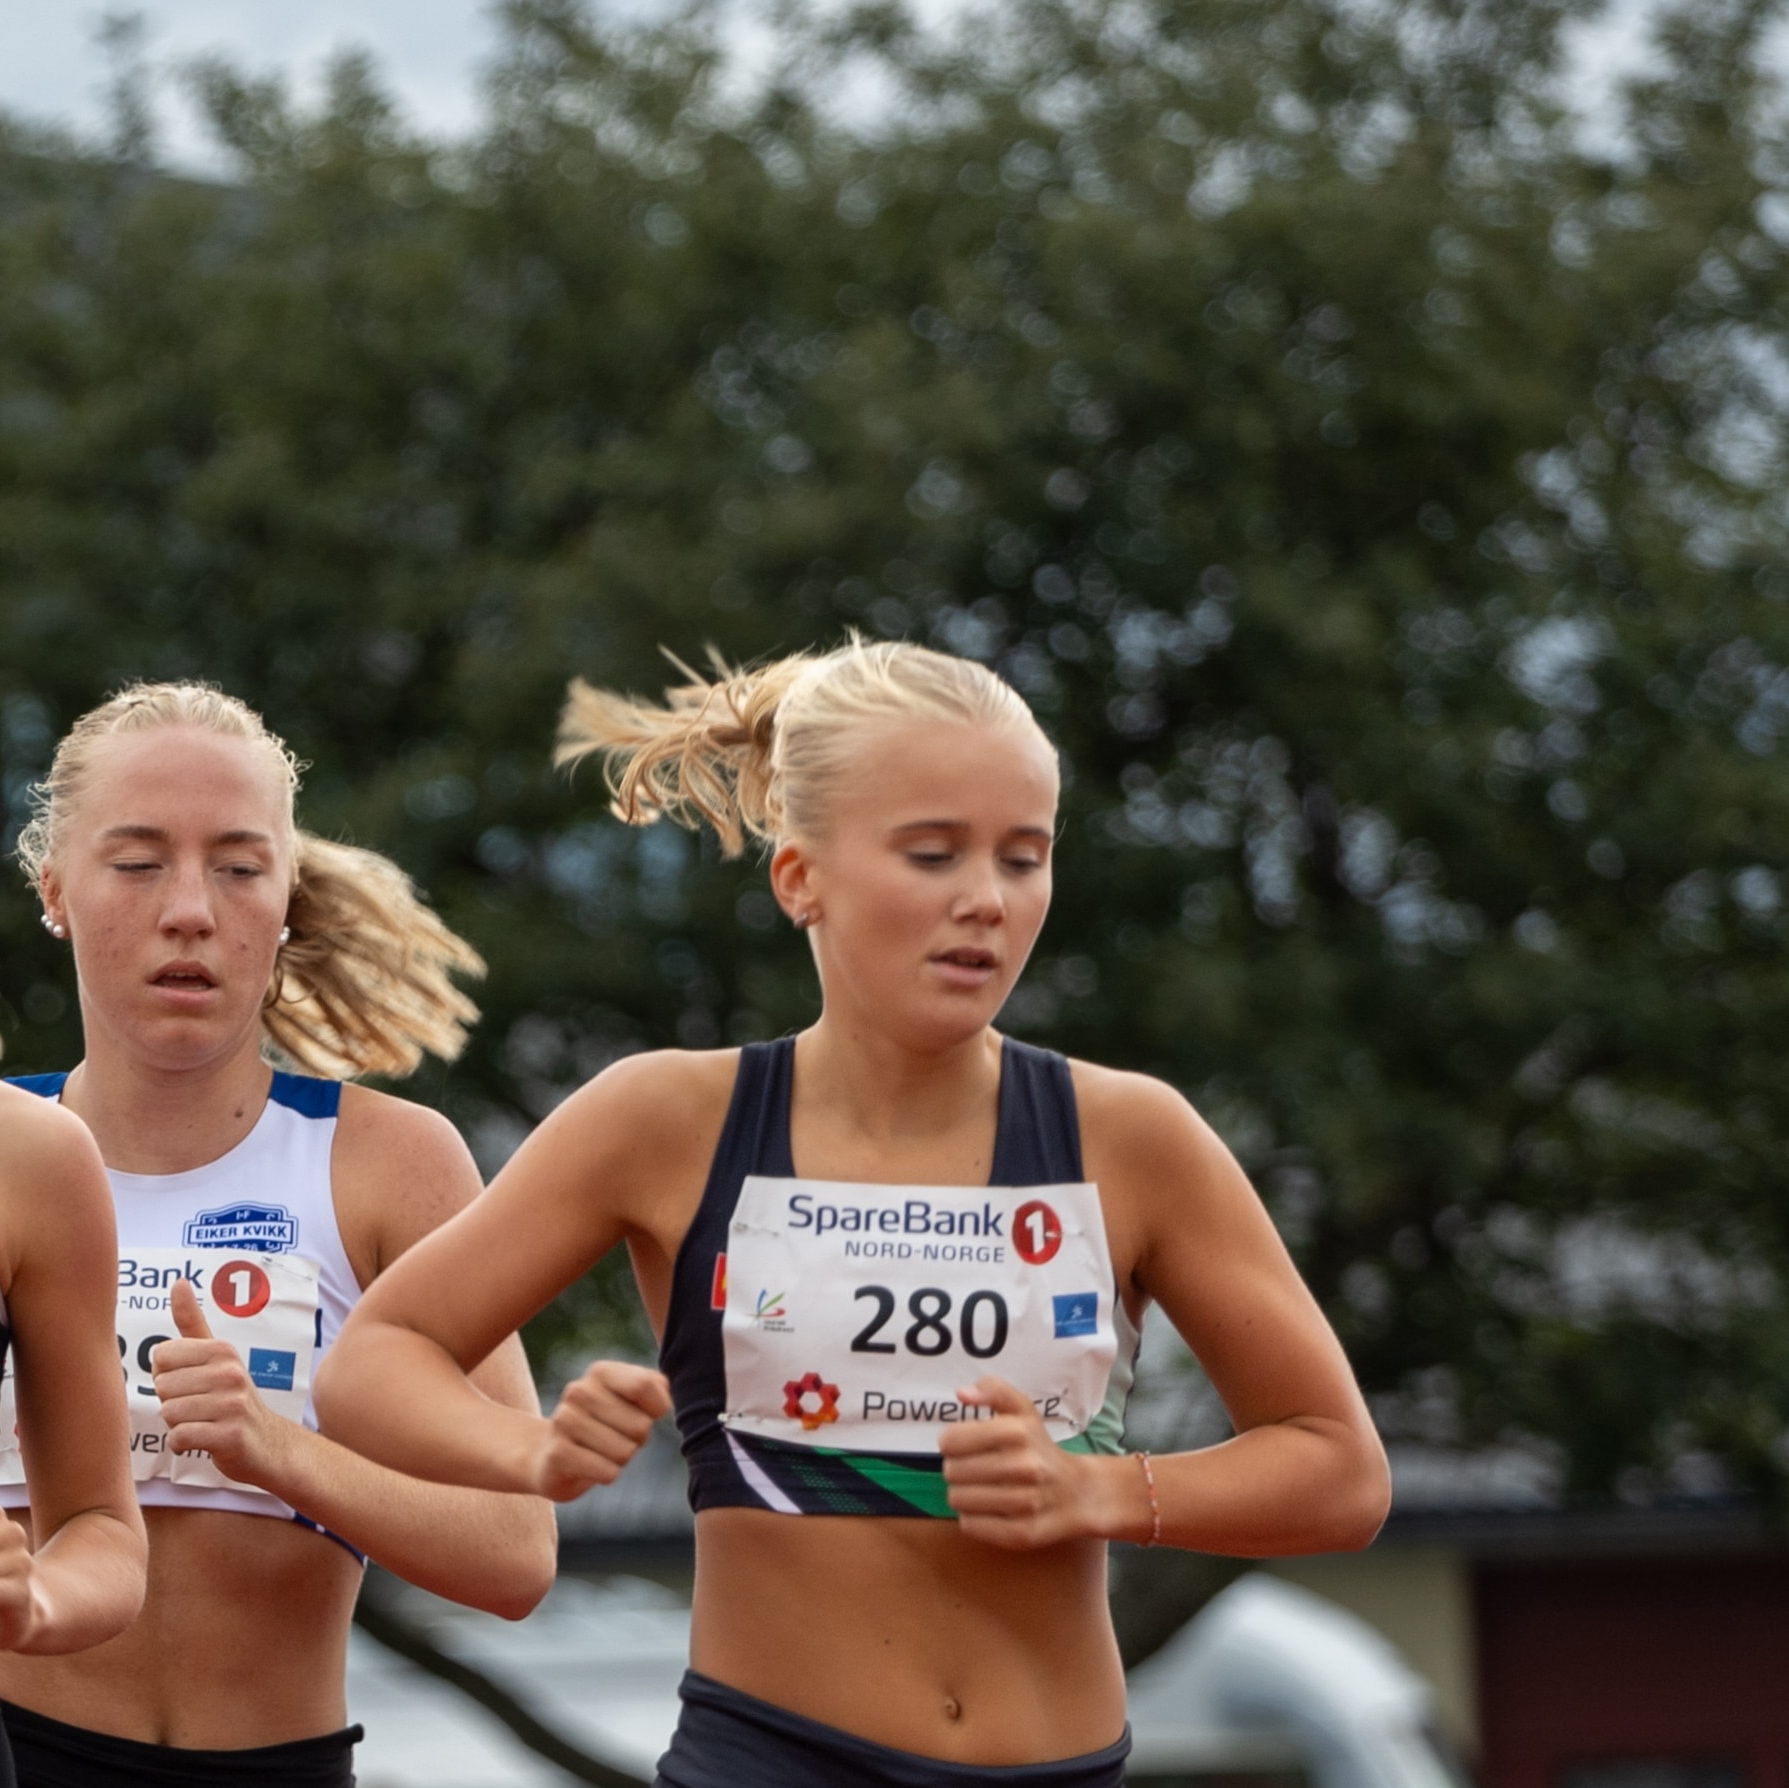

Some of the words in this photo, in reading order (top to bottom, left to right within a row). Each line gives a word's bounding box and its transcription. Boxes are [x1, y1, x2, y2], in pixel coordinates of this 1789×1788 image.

[787, 1194, 1003, 1236] SpareBank
[195, 1226, 238, 1240] EIKER
[243, 1225, 287, 1238] KVIKK
[844, 1241, 1005, 1263] NORD-NORGE
[850, 1284, 1010, 1359] 280
[862, 1390, 1063, 1423] Powere
